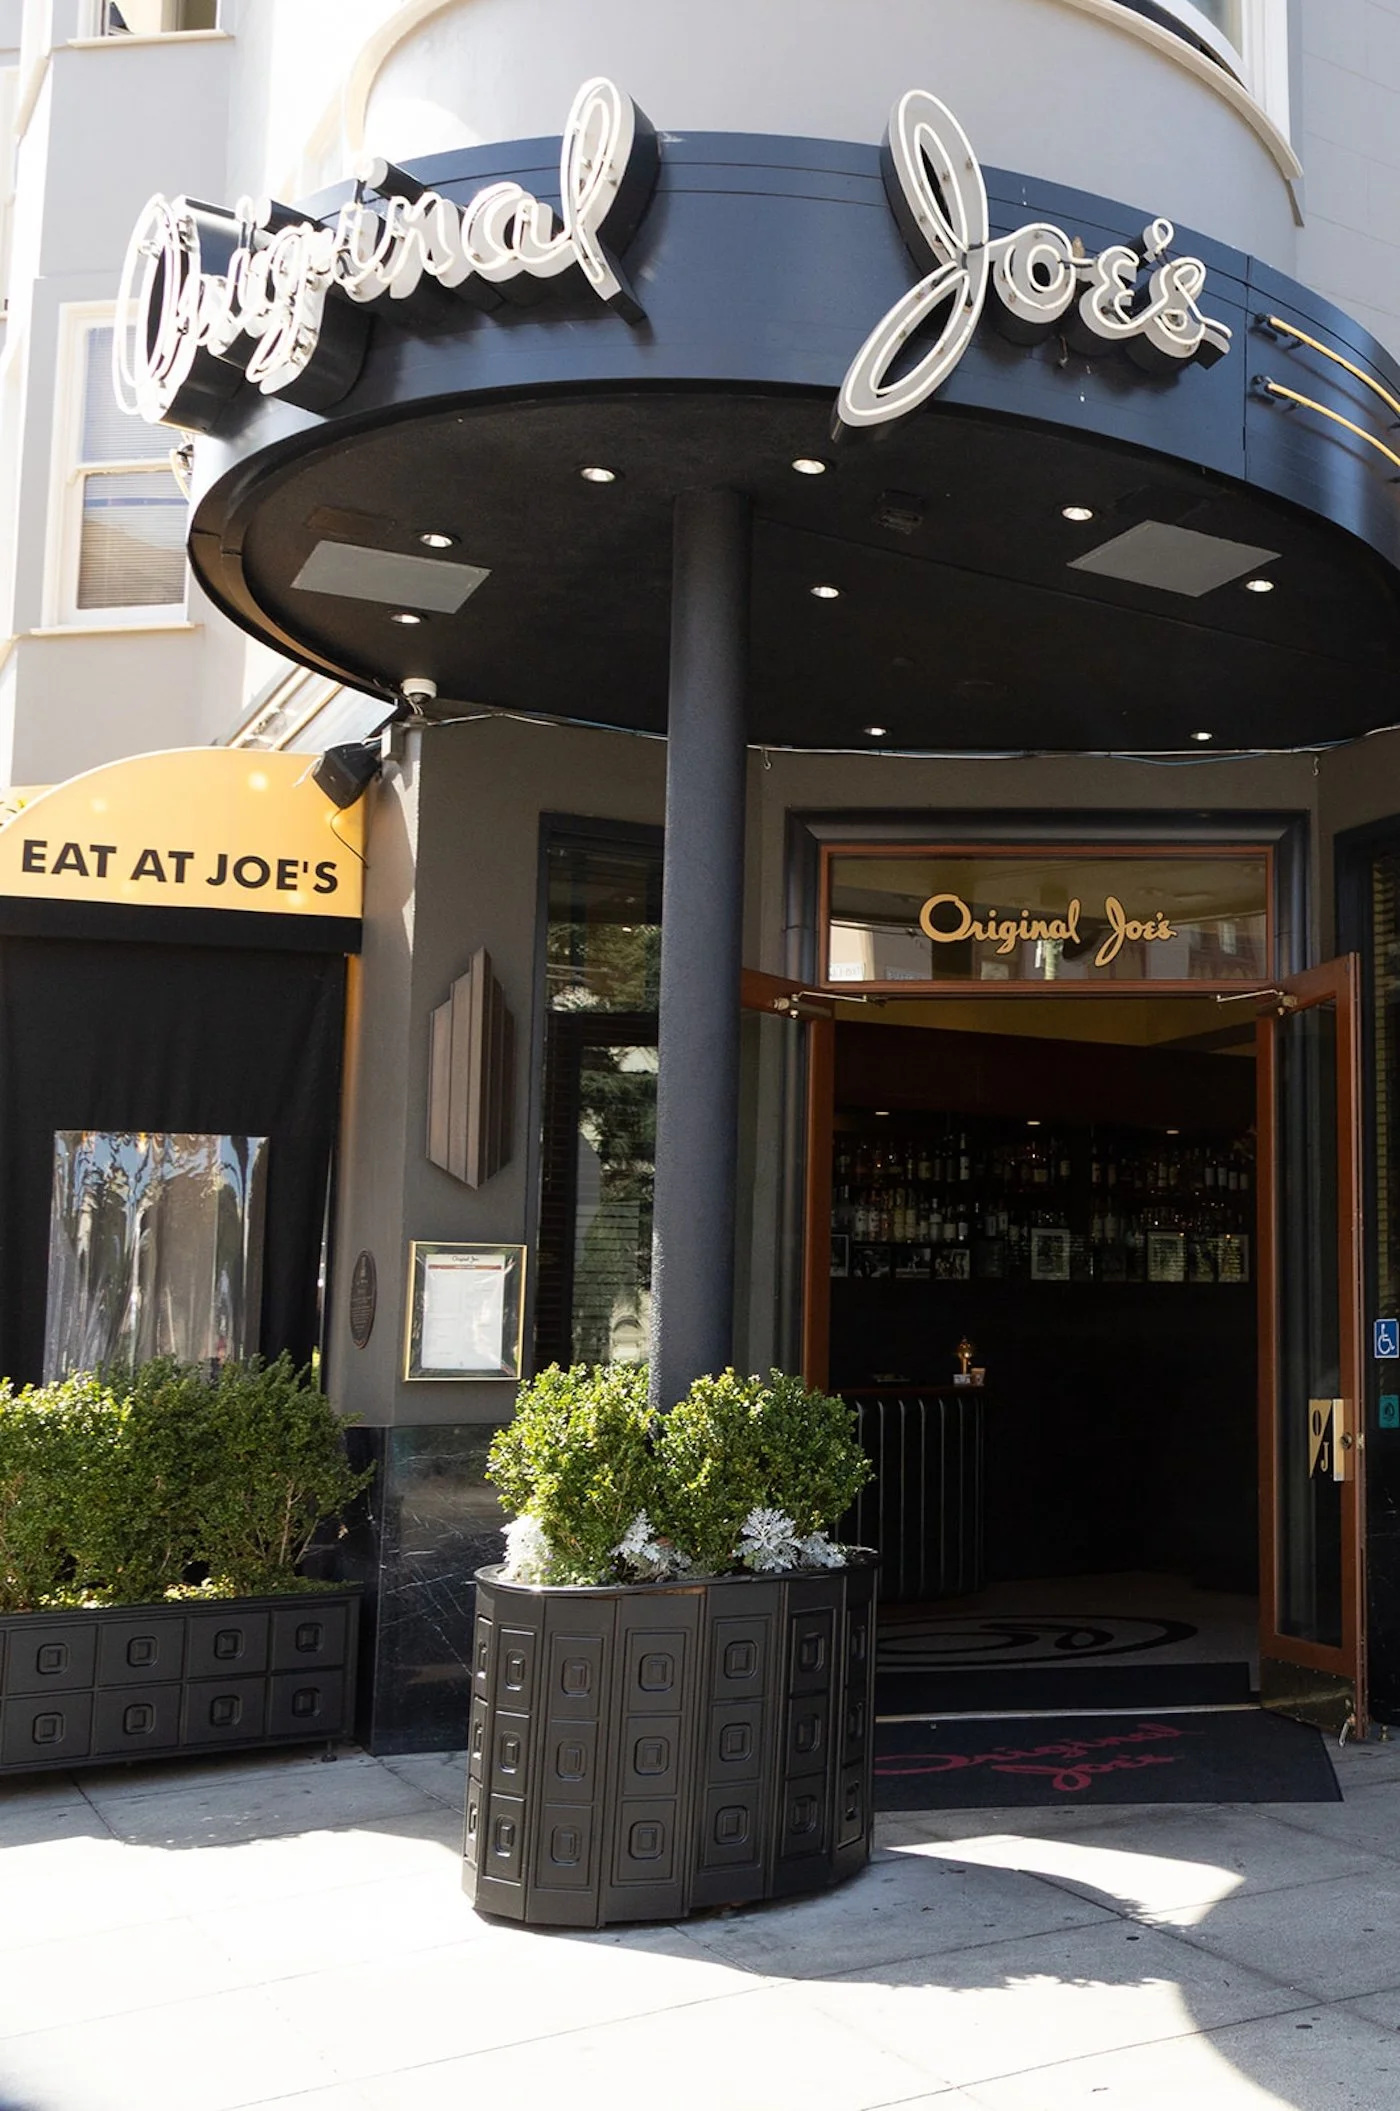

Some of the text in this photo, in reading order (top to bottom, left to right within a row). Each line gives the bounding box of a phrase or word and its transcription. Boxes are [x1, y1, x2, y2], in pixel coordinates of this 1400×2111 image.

[112, 76, 1232, 426] Original Joe's
[21, 839, 338, 894] EAT AT JOE'S
[919, 893, 1178, 967] Original Joe's
